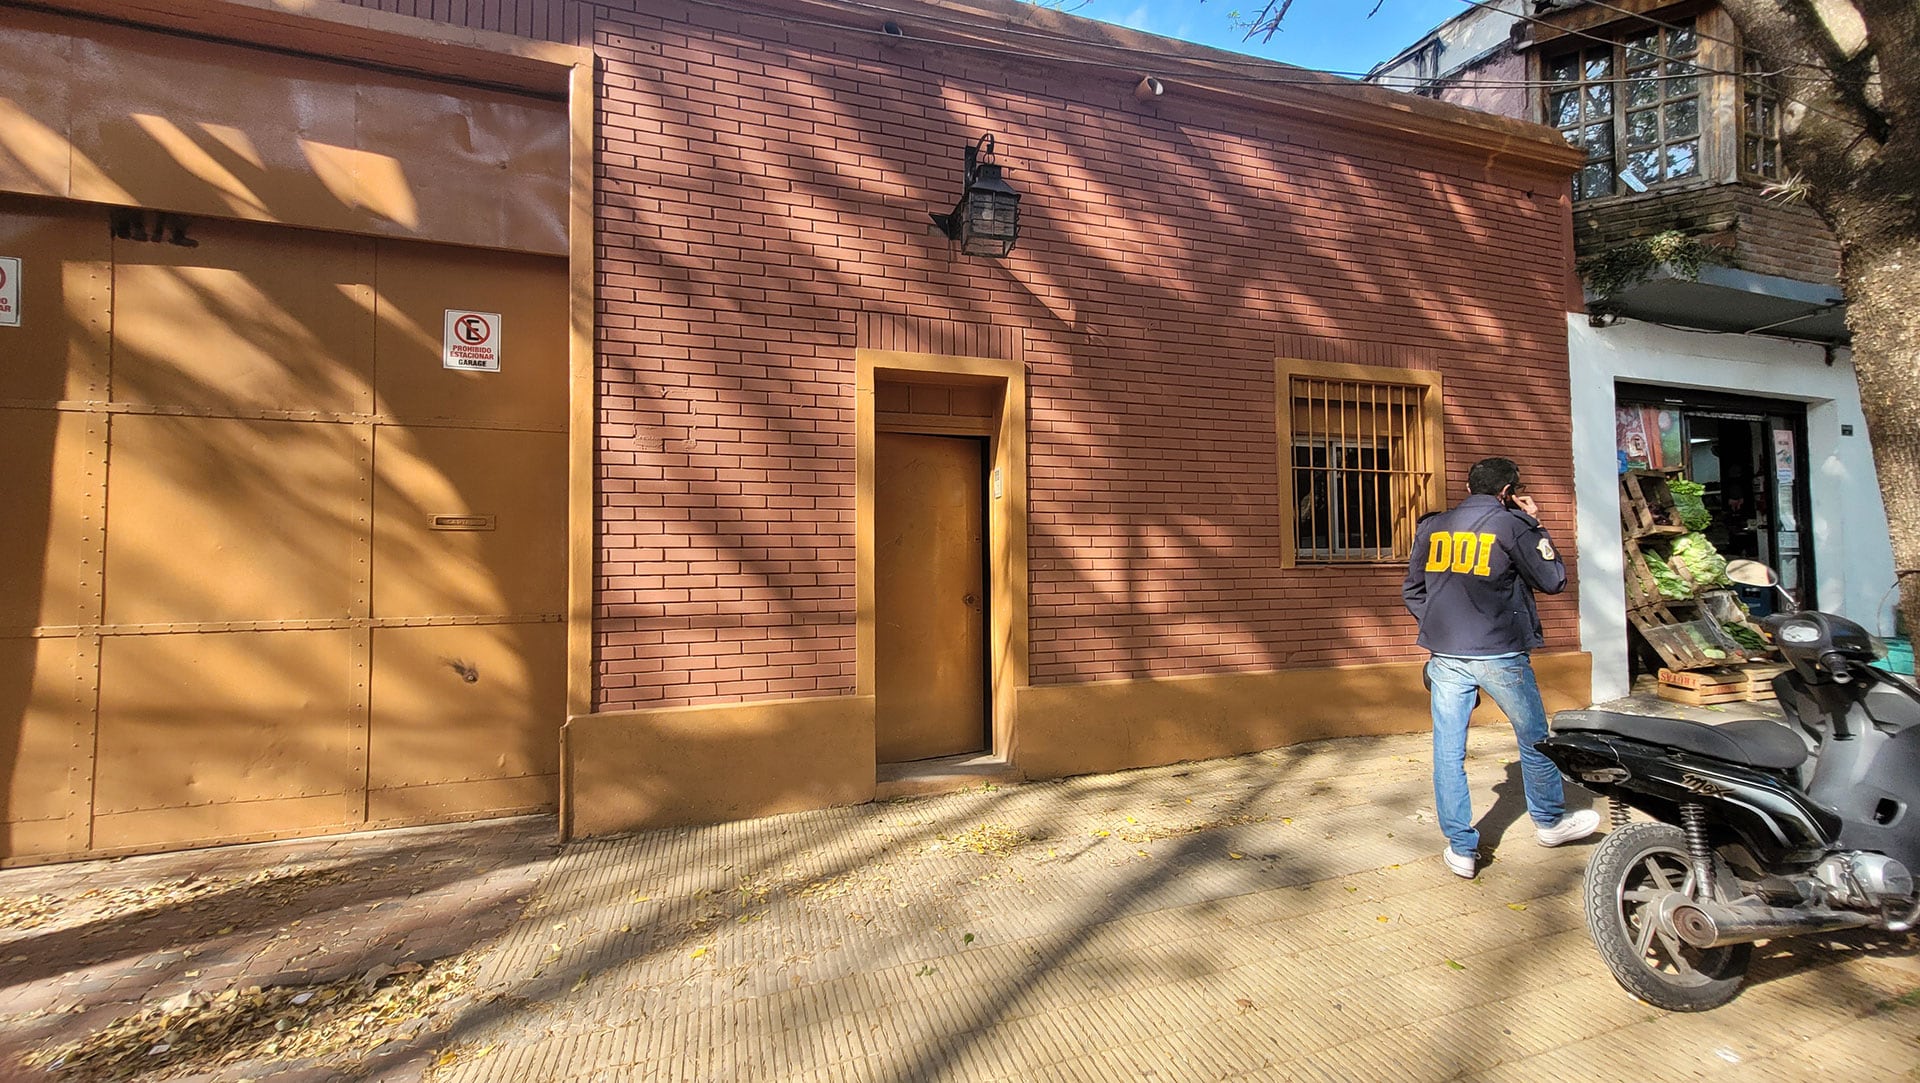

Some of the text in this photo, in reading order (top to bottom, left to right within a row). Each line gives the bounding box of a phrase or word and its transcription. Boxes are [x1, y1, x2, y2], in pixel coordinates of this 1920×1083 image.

[453, 345, 491, 353] PROHIBIDO
[450, 351, 494, 360] ESTACIONAR
[458, 359, 486, 367] GARAGE
[1425, 531, 1496, 576] DDI
